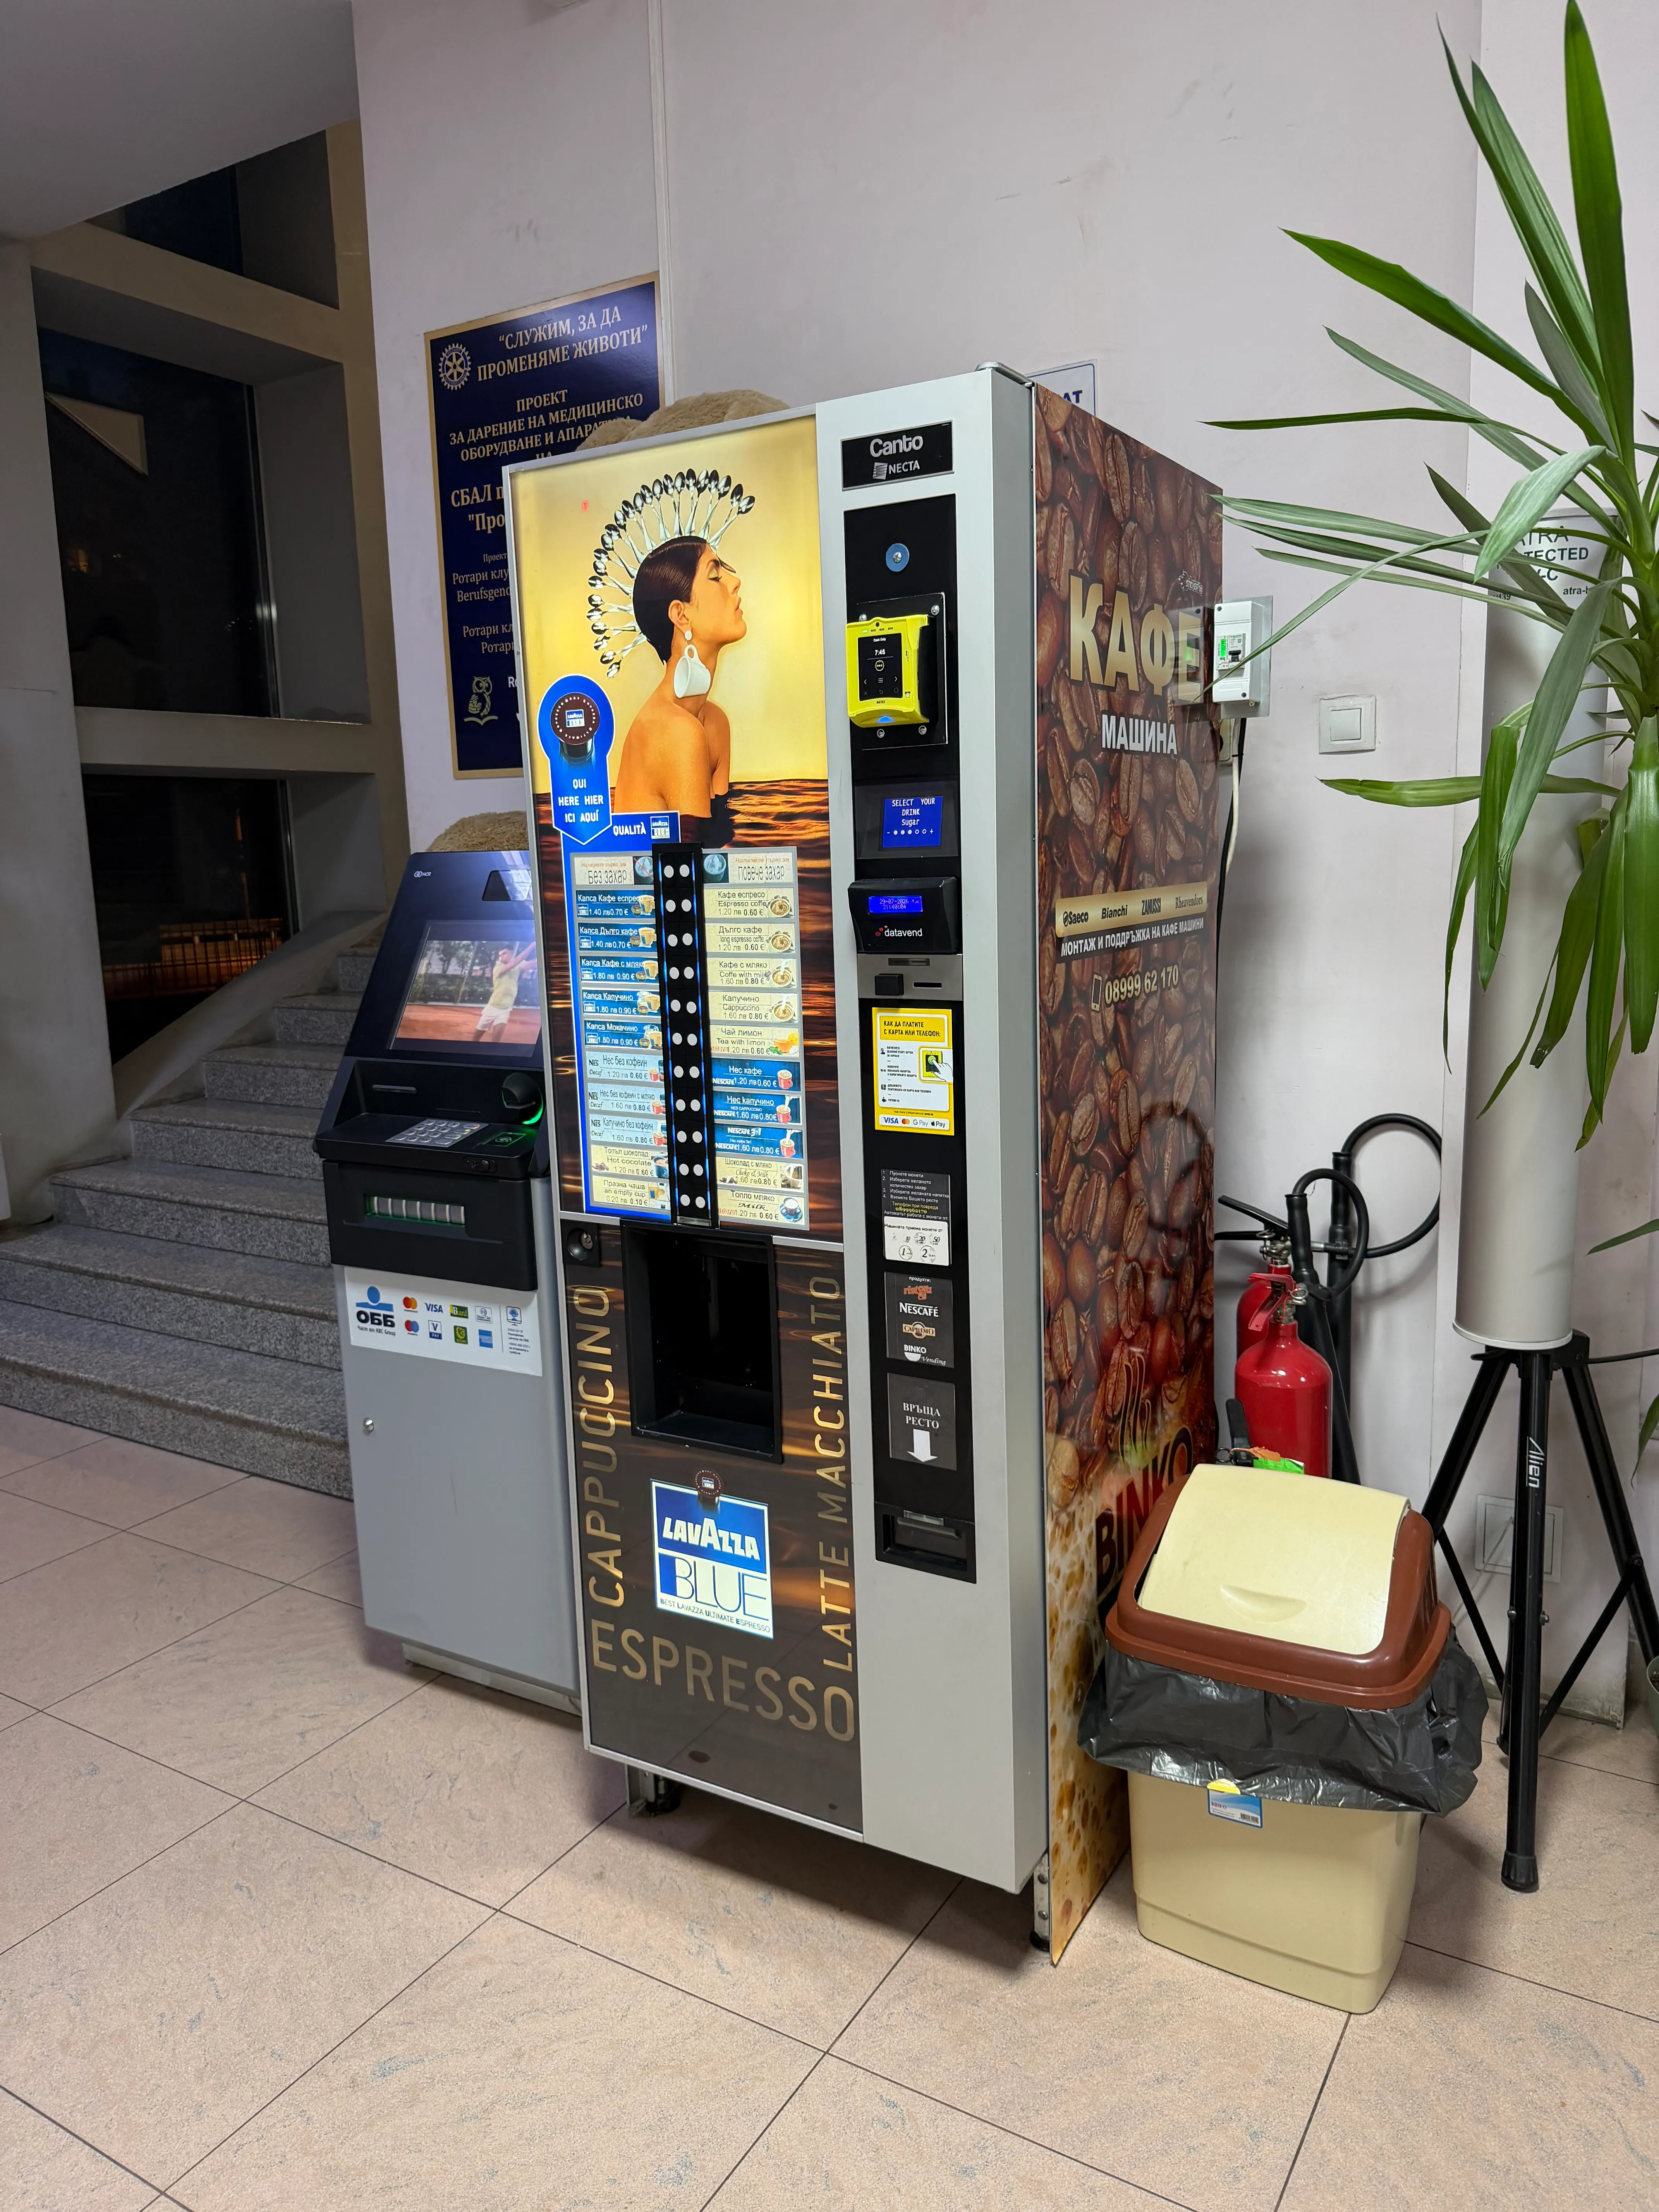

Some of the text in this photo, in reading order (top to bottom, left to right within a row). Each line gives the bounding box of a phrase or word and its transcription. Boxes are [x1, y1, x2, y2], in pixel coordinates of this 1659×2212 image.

[579, 313, 596, 331] ЗА
[601, 306, 621, 329] ДА
[477, 345, 569, 381] ПРОМЕНЯМЕ
[573, 324, 647, 359] ЖИВОТИ”
[517, 390, 567, 412] ПРОЕКТ
[450, 393, 643, 445] ЗА ДАРЕНИЕ НА МЕДИЦИНСКО
[460, 434, 541, 462] ОБОРУДВАНЕ
[544, 432, 554, 444] И
[870, 435, 923, 457] Canto
[889, 460, 920, 474] NECTA
[451, 484, 492, 507] СБАЛ
[483, 553, 508, 563] Проект
[453, 572, 488, 584] Ротари
[463, 625, 498, 638] Ротари
[1070, 575, 1201, 704] КАФЕ
[1102, 714, 1177, 755] МАШИНА
[573, 779, 586, 789] QUI
[558, 795, 604, 806] HERE HIER
[565, 809, 599, 823] ICI AQUÍ
[902, 818, 920, 827] Sugar
[613, 822, 646, 836] QUALITÀ
[588, 870, 627, 884] Без захар
[738, 866, 785, 881] Повече захар
[1069, 894, 1203, 925] Saeco Bianchi ZANUSSI Rheavendors
[601, 927, 619, 935] Дълго
[719, 926, 741, 934] Дълго
[884, 928, 922, 936] datavend
[1061, 917, 1204, 957] МОНТАЖ И ПОДДРЪЖКА НА КАФЕ МАШИНИ
[1105, 965, 1179, 1004] 08999 62 170
[603, 993, 633, 1001] Капучино
[723, 994, 759, 1003] Капучино
[607, 1024, 637, 1032] Мокачино
[603, 1055, 647, 1068] Нес без кофеин
[744, 1068, 762, 1076] кафе
[604, 1180, 627, 1188] Празна
[731, 1190, 752, 1199] Топло
[738, 1203, 768, 1211] Milk
[424, 1302, 443, 1313] VISA
[900, 1302, 939, 1317] NESCAFÉ
[356, 1310, 396, 1328] ОББ
[904, 1325, 934, 1335] CAPRIMO
[904, 1344, 927, 1353] BINKO
[921, 1356, 946, 1366] Vending
[903, 1402, 941, 1417] ВРЪЩА
[905, 1415, 939, 1429] РЕСТО
[574, 1285, 624, 1607] CAPPUCCINO
[1528, 1436, 1545, 1488] Alien
[809, 1276, 852, 1672] LATTE MACCHIATO
[663, 1517, 760, 1560] LAVAZZA
[658, 1553, 768, 1621] BLUE
[660, 1598, 770, 1633] BEST LAVAZZA ULTIMATE ESPRESSO
[592, 1618, 855, 1741] ESPRESSO
